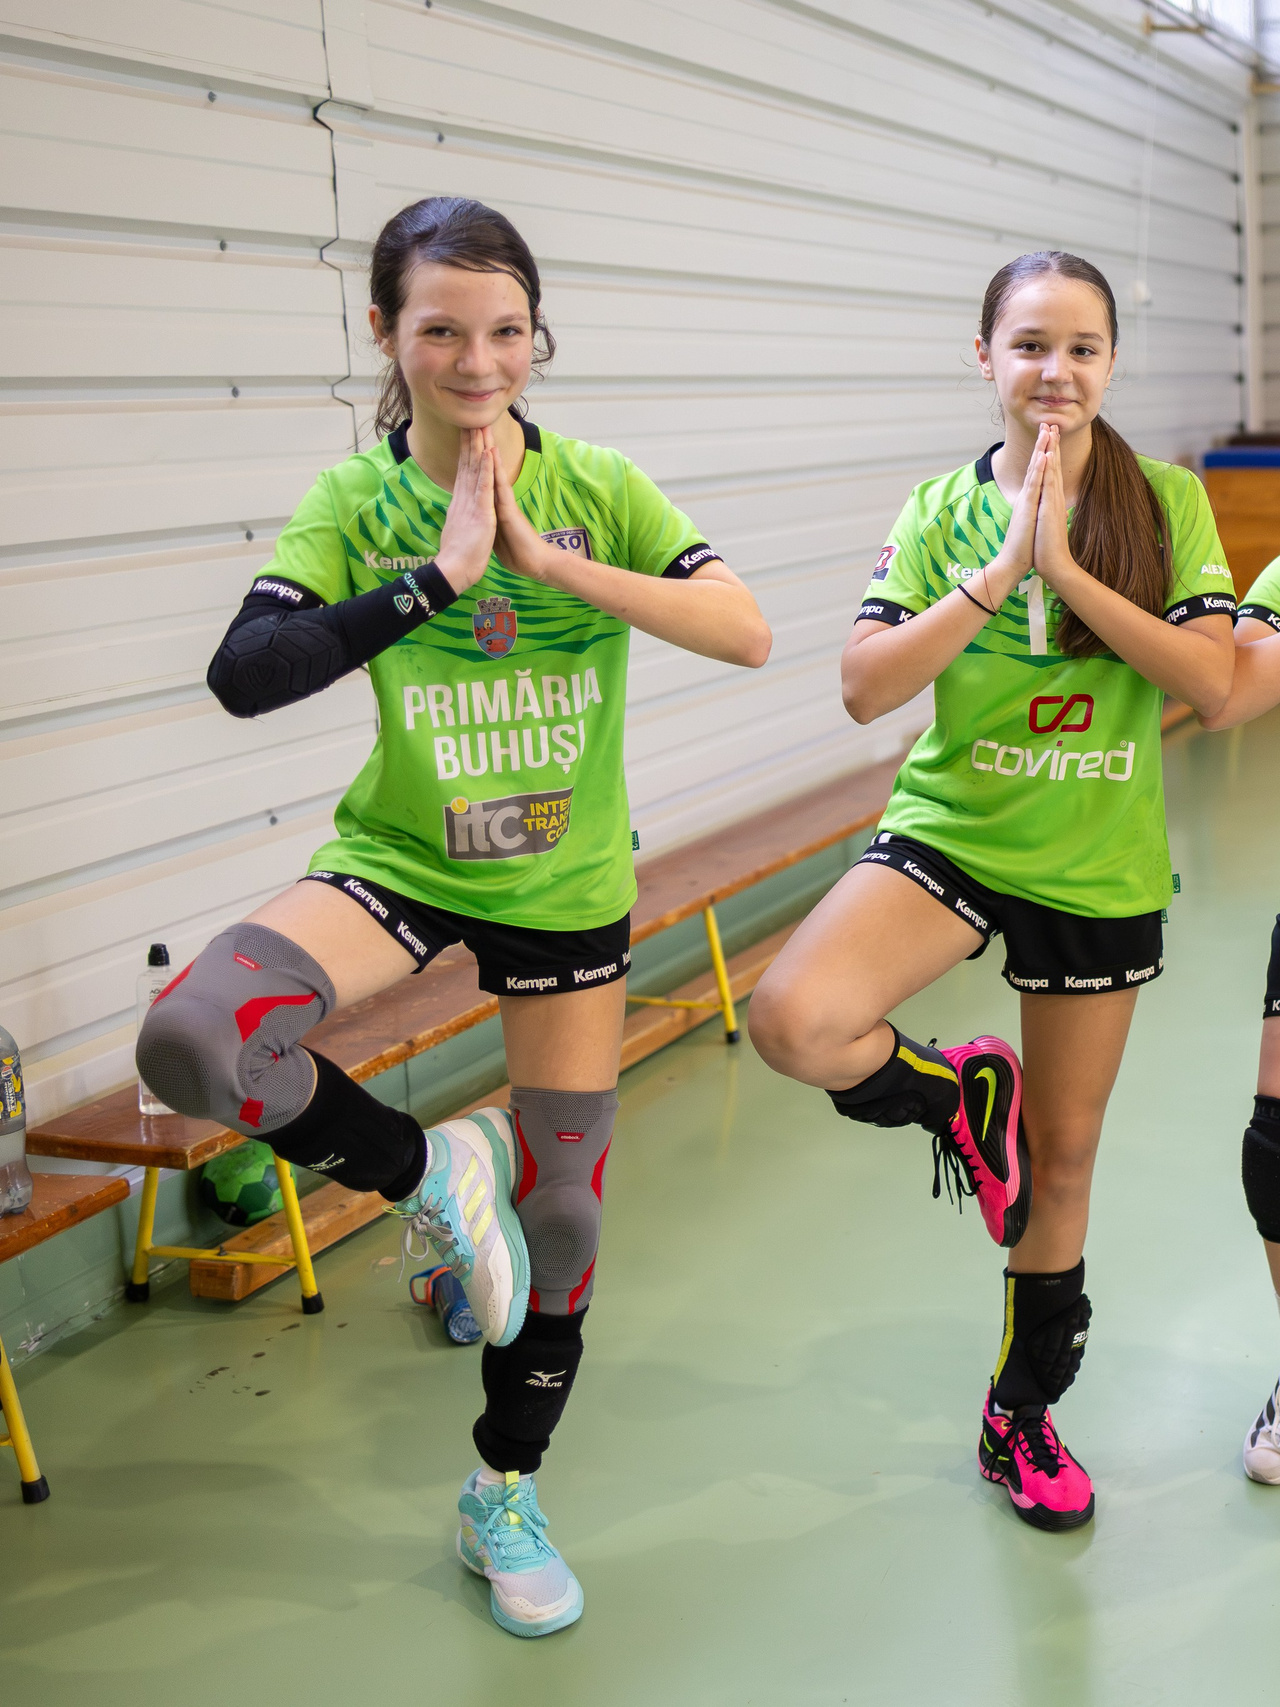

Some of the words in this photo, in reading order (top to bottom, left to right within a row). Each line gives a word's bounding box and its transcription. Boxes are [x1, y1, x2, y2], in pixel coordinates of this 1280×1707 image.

[253, 579, 304, 602] Kempa
[1202, 597, 1237, 612] Kempa
[402, 667, 603, 731] PRIMĂRIA
[433, 718, 586, 781] BUHUȘI
[970, 738, 1137, 782] covired
[902, 860, 946, 897] Kempa
[955, 897, 989, 930] Kempa
[343, 878, 390, 919] Kempa
[396, 920, 429, 957] Kempa
[506, 976, 559, 991] Kempa
[573, 962, 618, 983] Kempa
[1008, 970, 1050, 991] Kempa
[1064, 975, 1113, 991] Kempa
[1125, 964, 1156, 983] Kempa
